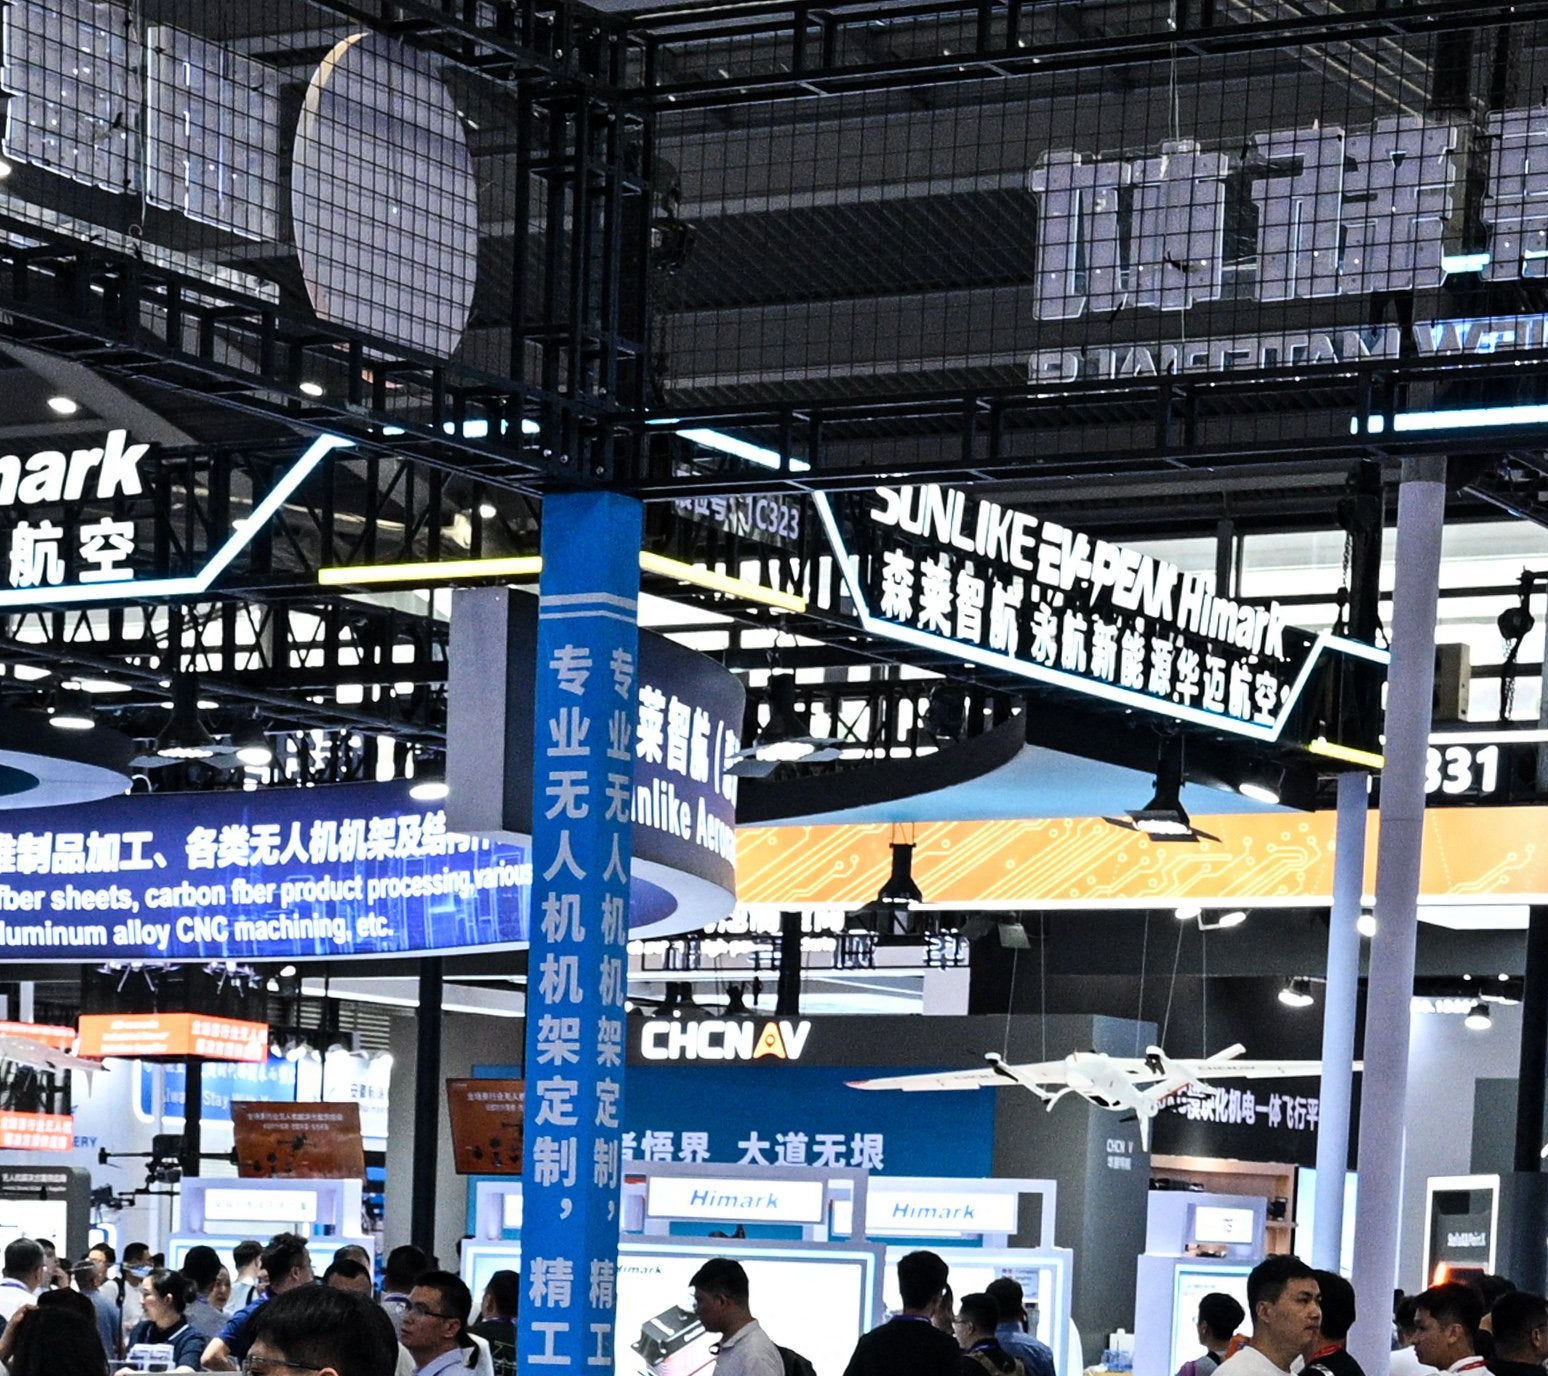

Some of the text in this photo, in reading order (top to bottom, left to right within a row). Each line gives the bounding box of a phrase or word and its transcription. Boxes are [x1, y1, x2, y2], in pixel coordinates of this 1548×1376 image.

[870, 483, 1039, 571] SUNLIKE
[1177, 570, 1286, 660] Himark
[50, 883, 140, 913] sheets,
[145, 880, 233, 909] carbon
[280, 873, 369, 909] product
[112, 919, 171, 950] alloy
[176, 916, 228, 943] CNC
[234, 912, 352, 946] machining,
[356, 911, 395, 938] etc.
[641, 1020, 812, 1060] CHCNAV
[736, 1130, 886, 1170] 大道无垠
[690, 1189, 780, 1210] Himark
[892, 1203, 976, 1221] Himark
